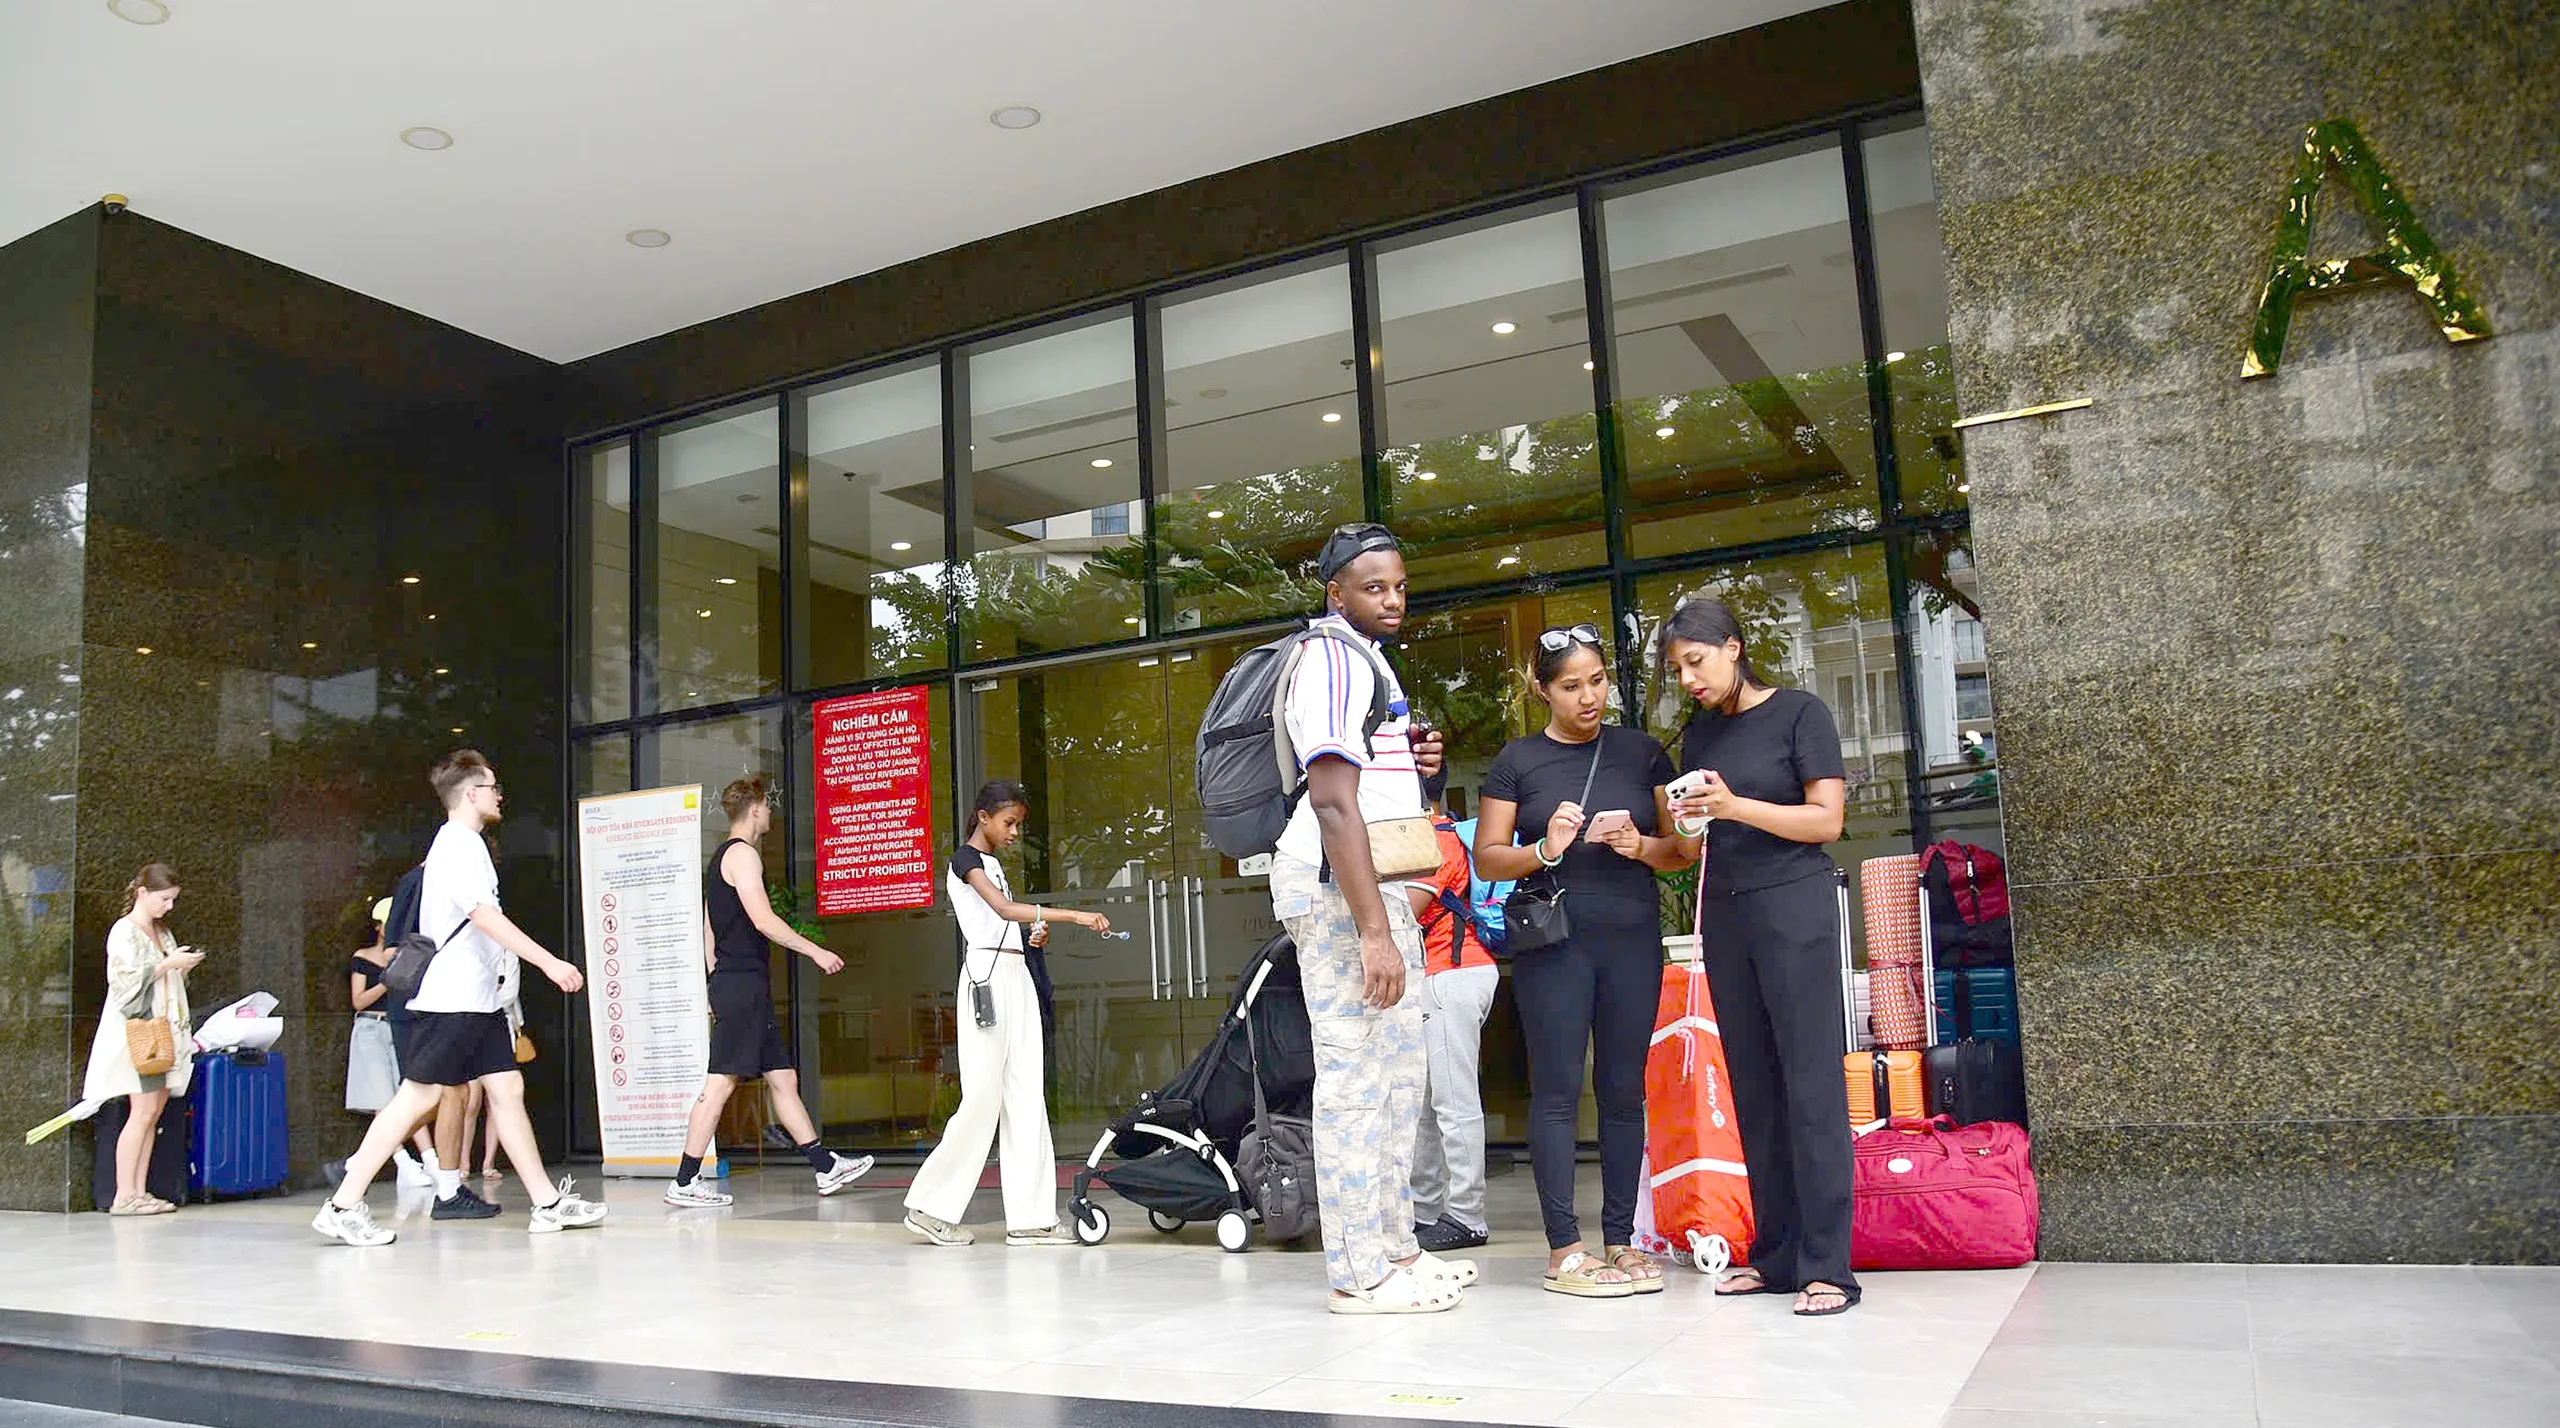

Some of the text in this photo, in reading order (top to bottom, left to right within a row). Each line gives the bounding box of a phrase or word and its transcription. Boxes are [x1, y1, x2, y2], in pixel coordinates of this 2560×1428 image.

[2241, 117, 2494, 379] A
[833, 714, 878, 731] NGHIÊM
[867, 730, 887, 739] DỤNG
[822, 745, 847, 755] CHUNG
[863, 738, 901, 750] OFFICETEL
[903, 735, 920, 744] KINH
[832, 755, 856, 764] DOANH
[857, 762, 875, 770] THEO
[892, 757, 920, 767] (Airbnb)
[839, 773, 863, 783] CHUNG
[878, 767, 918, 778] RIVERGATE
[851, 780, 892, 792] RESIDENCE
[829, 798, 916, 814] USING APARTMENTS AND
[832, 808, 915, 825] OFFICETEL FOR SHORT-
[840, 820, 907, 834] TERM AND HOURLY
[824, 828, 924, 846] ACCOMMODATION BUSINESS
[835, 840, 913, 856] (Airbnb) AT RIVERGATE
[828, 850, 921, 866] RESIDENCE APARTMENT IS
[823, 862, 927, 881] STRICTLY PROHIBITED
[1706, 1063, 1717, 1110] Safety
